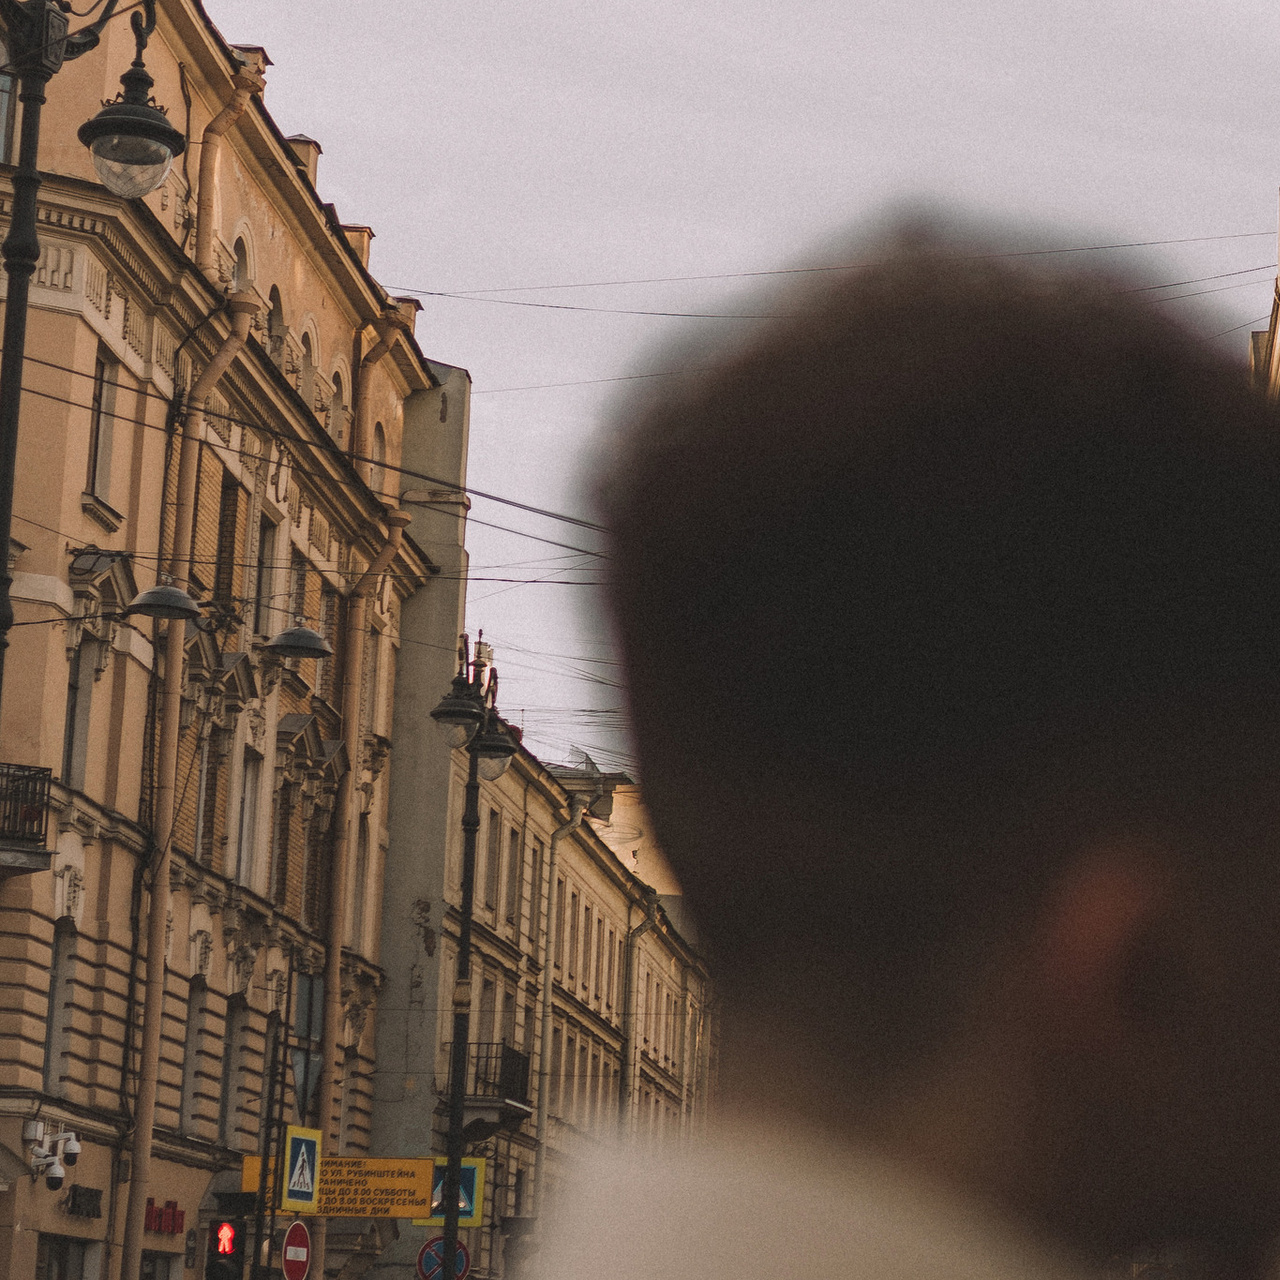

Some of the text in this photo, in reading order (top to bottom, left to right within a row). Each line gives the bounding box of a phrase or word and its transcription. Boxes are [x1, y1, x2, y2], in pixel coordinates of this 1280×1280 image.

[347, 1169, 415, 1178] РУБИНШТЕЙНА
[319, 1178, 367, 1187] РАНИЧЕНО
[338, 1187, 351, 1196] ДО
[353, 1187, 371, 1196] 8.00
[373, 1188, 416, 1197] СУББОТЫ
[324, 1196, 337, 1205] ДО
[339, 1196, 357, 1205] 8.00
[359, 1197, 427, 1206] ВОСКРЕСЕНЬЯ
[370, 1206, 390, 1215] ДНИ
